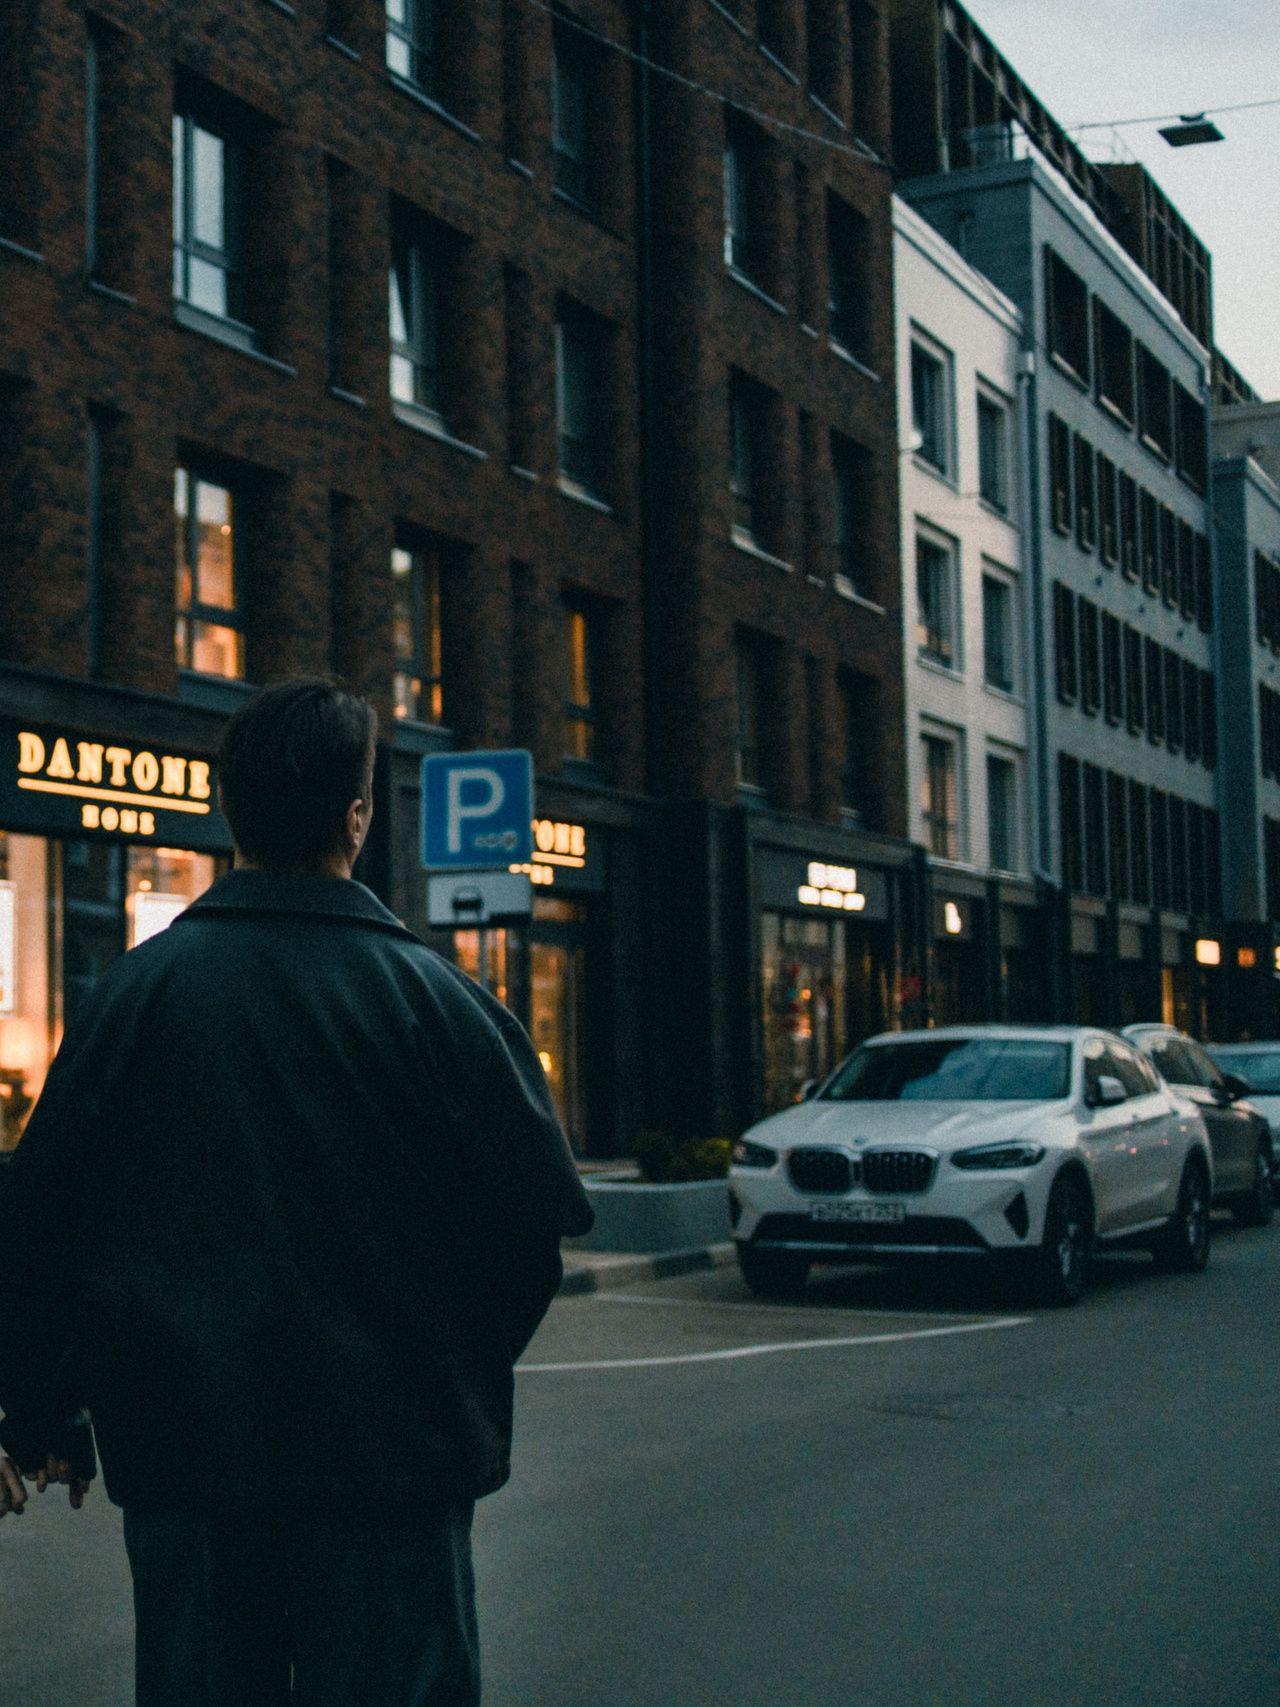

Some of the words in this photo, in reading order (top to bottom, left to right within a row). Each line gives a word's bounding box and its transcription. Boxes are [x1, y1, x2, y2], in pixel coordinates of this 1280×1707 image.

[17, 731, 211, 799] DANTONE
[81, 804, 155, 836] HOME
[448, 767, 505, 854] P
